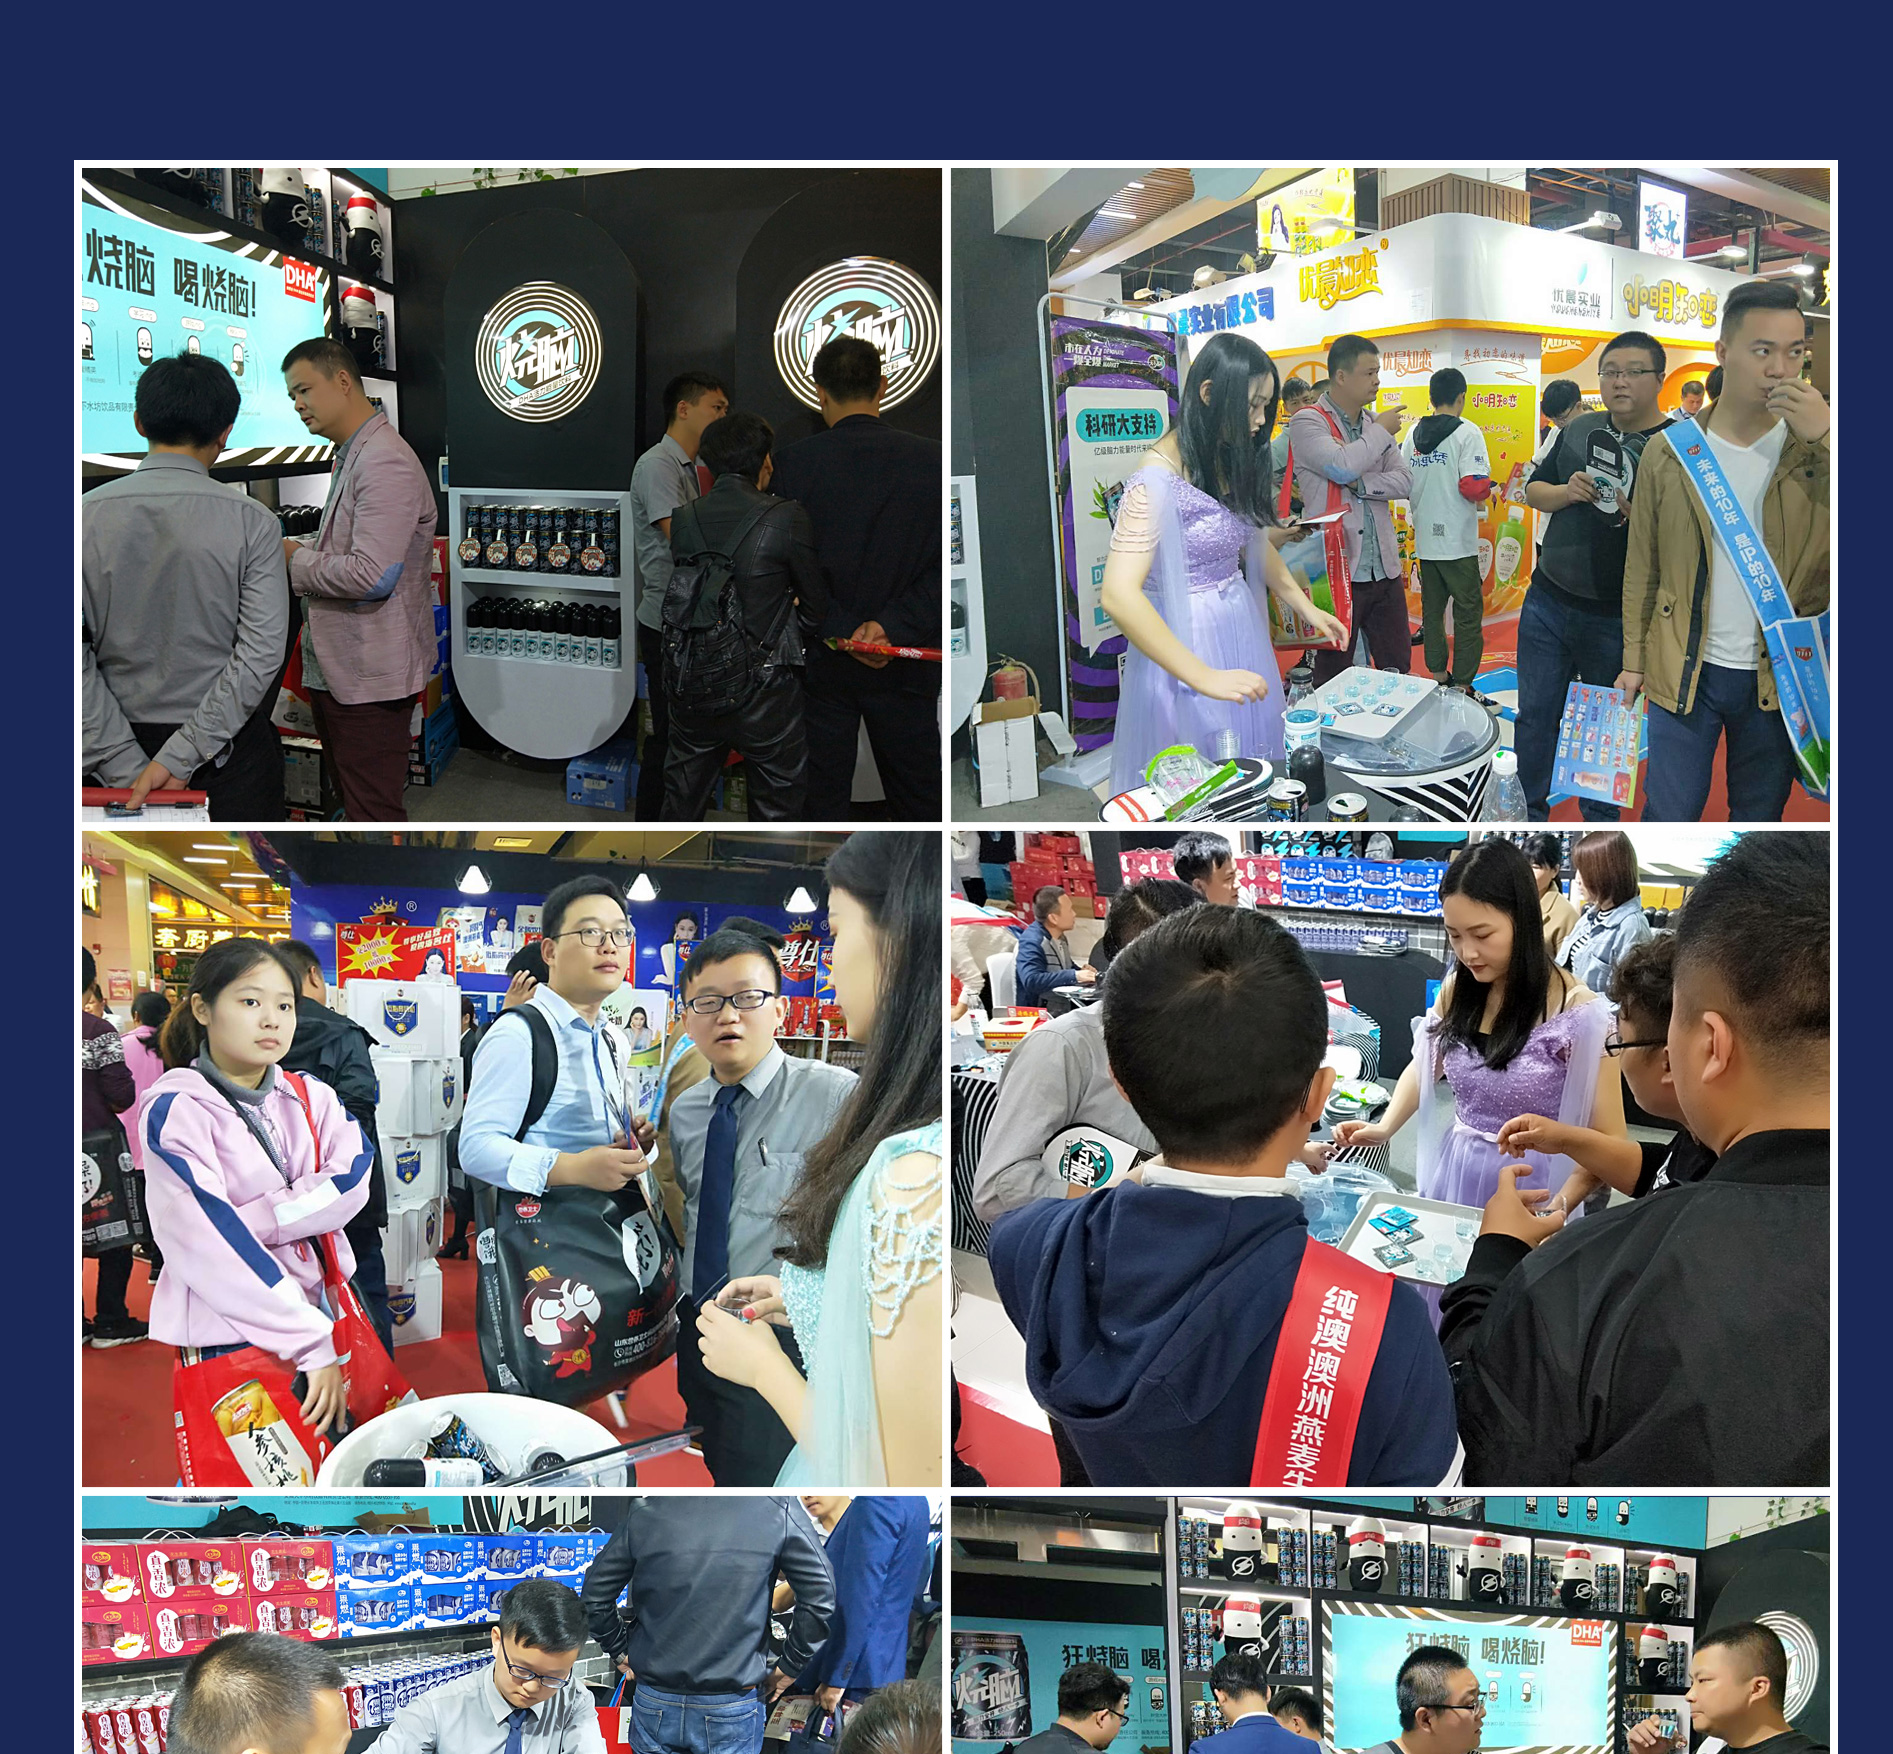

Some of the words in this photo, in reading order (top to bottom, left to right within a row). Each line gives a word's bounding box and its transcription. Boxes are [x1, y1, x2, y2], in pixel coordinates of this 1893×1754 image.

[82, 228, 155, 296] 烧脑
[174, 257, 256, 318] 喝烧脑!
[1085, 413, 1157, 438] 科研大支持
[1696, 458, 1740, 526] 未来的10年
[1734, 532, 1778, 603] 是IP的10年
[779, 939, 819, 967] 尊仕
[1062, 1645, 1130, 1670] 狂烧脑
[1481, 1636, 1546, 1666] 喝烧脑!
